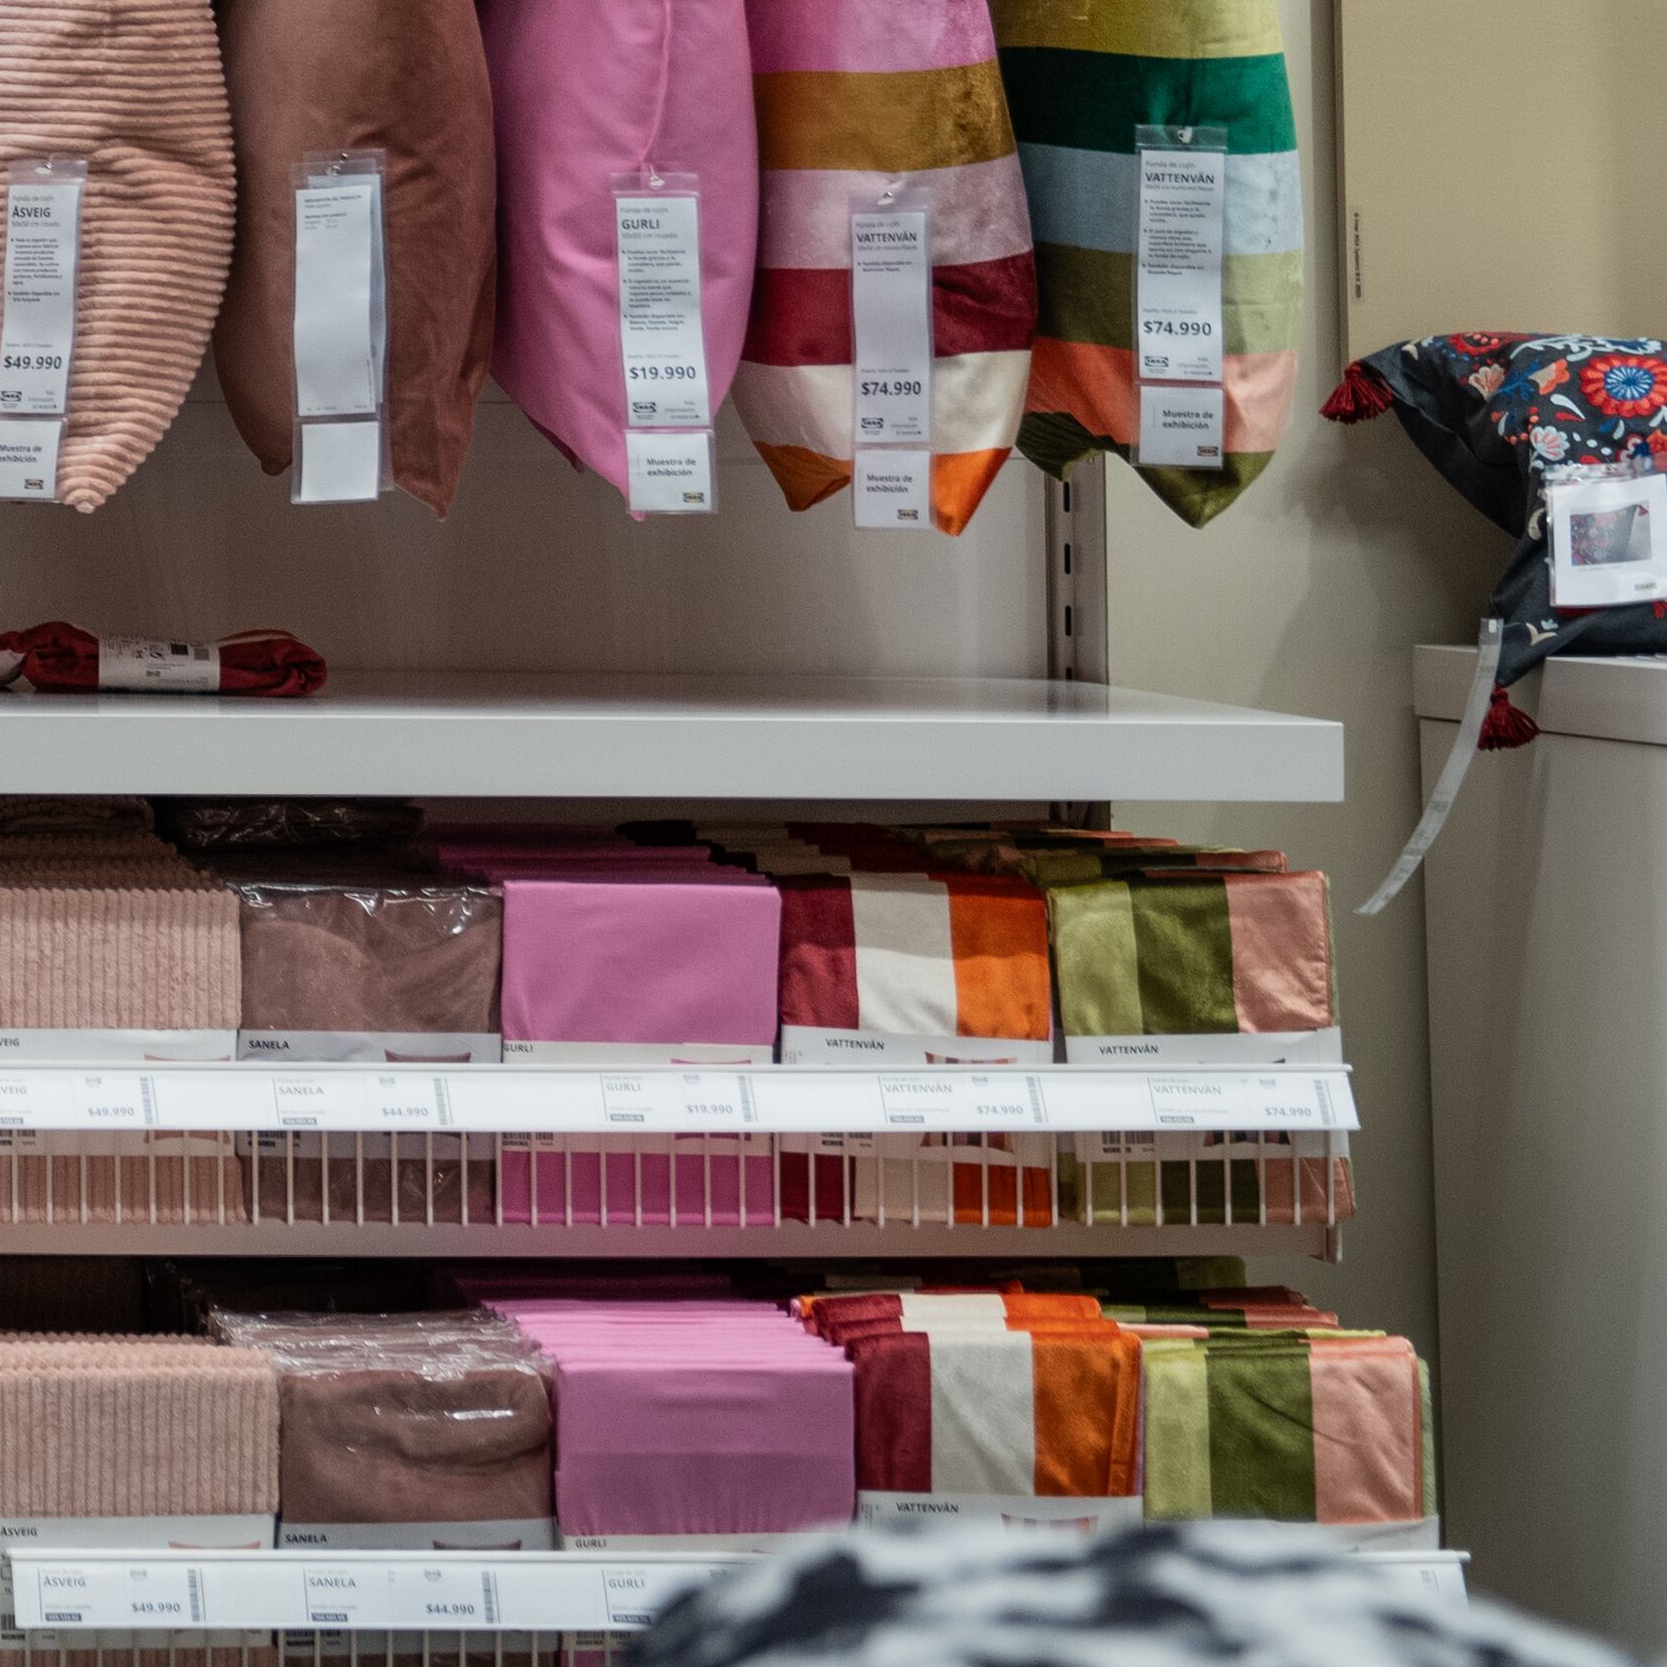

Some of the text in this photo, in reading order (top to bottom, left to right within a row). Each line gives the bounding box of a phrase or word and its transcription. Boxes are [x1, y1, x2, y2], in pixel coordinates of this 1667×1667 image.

[1144, 172, 1214, 184] VATTENVÄN
[11, 205, 51, 219] ÅSVEIG
[621, 218, 660, 230] GURLI
[856, 230, 917, 243] VATTENVÄN
[1143, 320, 1212, 336] $74.990
[3, 355, 62, 370] $49.990
[628, 365, 697, 380] $19.990
[860, 381, 922, 395] $74.990
[1162, 410, 1214, 419] Muestra de
[0, 444, 42, 453] Muestra de
[646, 457, 697, 466] Muestra de
[866, 473, 913, 482] Muestra de
[249, 1039, 290, 1050] SANELA
[503, 1042, 534, 1053] GURLI
[825, 1037, 885, 1051] VATTENVÄN
[1098, 1043, 1159, 1056] VATTENVÄN
[277, 1085, 324, 1096] SANELA
[605, 1081, 642, 1093] GURLI
[884, 1082, 953, 1094] VATTENVÄN
[1153, 1083, 1223, 1096] VATTENVÄN
[87, 1106, 135, 1118] $49.990
[381, 1106, 428, 1118] $44.990
[686, 1103, 734, 1115] $19.990
[976, 1104, 1024, 1116] $74.990
[1264, 1106, 1312, 1118] $74.990
[895, 1502, 959, 1515] VATTENVÄN
[0, 1525, 38, 1537] ÅSVEIG
[284, 1533, 328, 1544] SANELA
[575, 1537, 607, 1549] GURLI
[42, 1575, 87, 1588] ÅSVEIG
[308, 1576, 357, 1589] SANELA
[608, 1577, 646, 1590] GURLI
[131, 1602, 181, 1614] $49.990
[425, 1603, 475, 1616] $44.990
